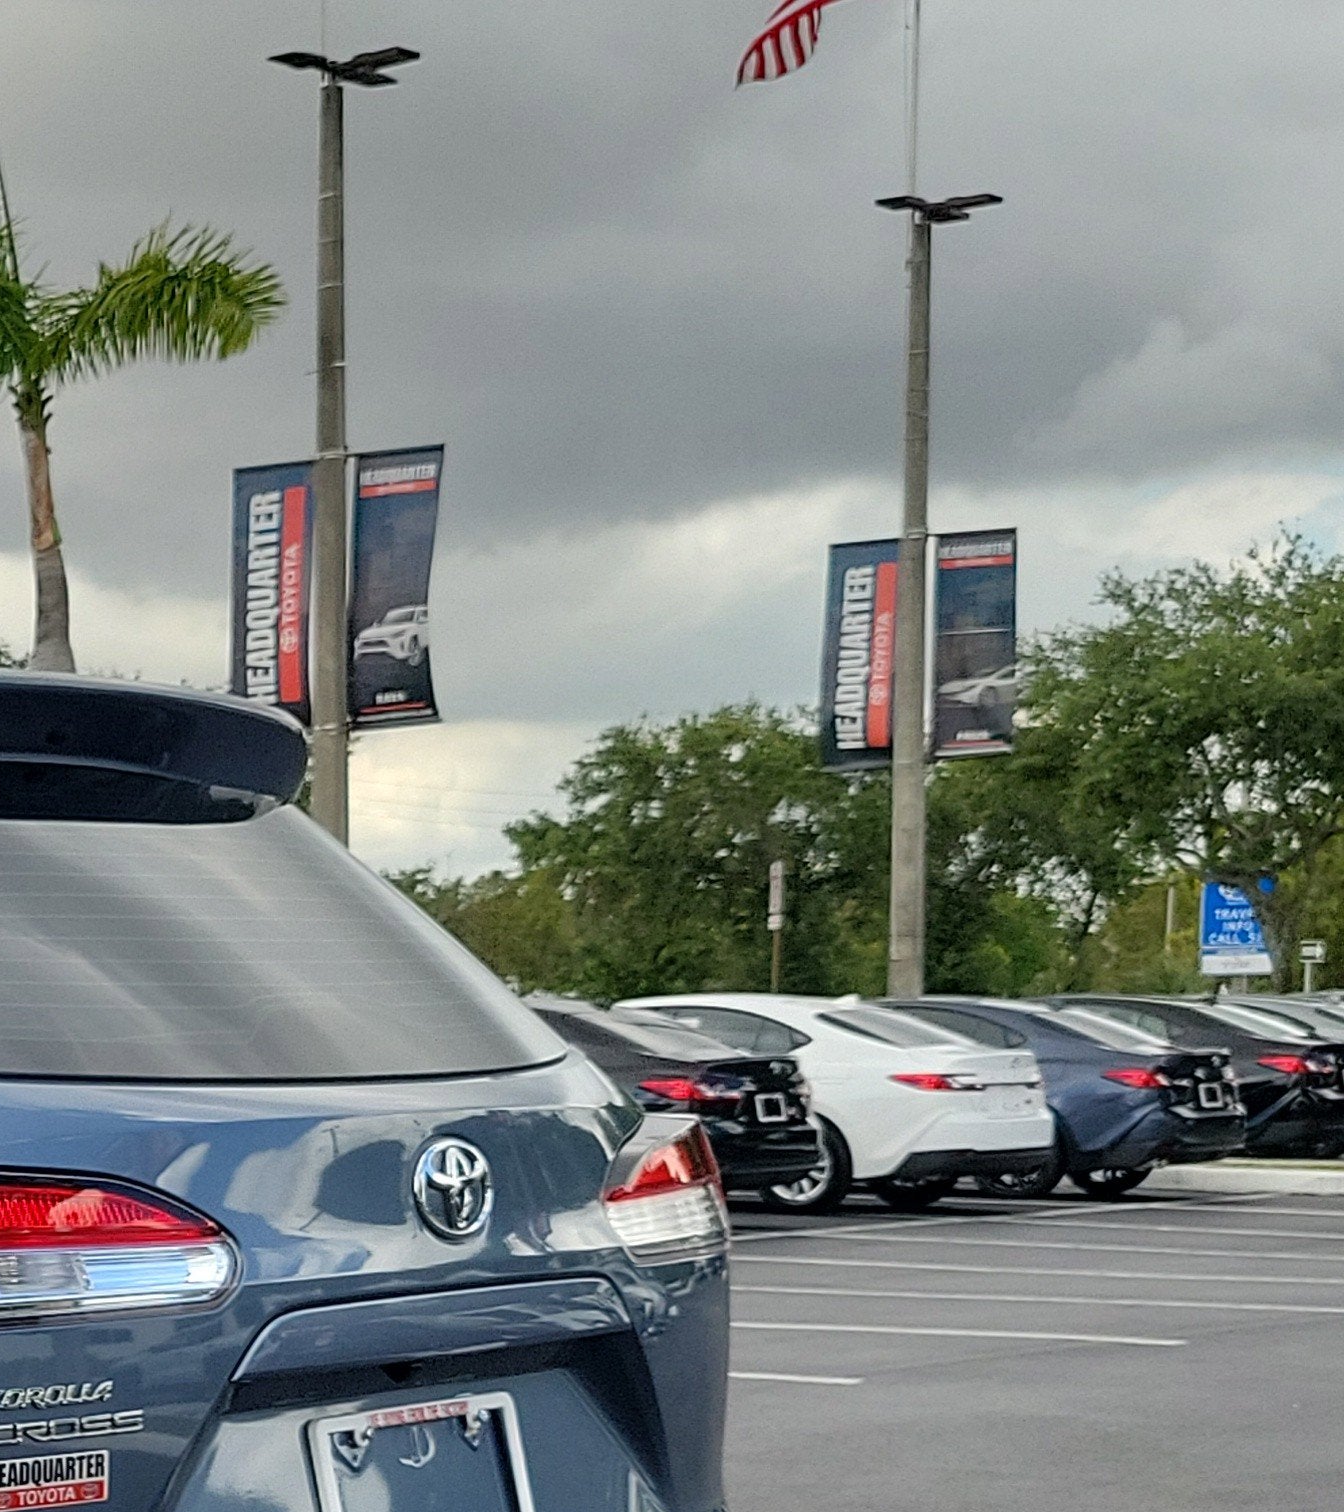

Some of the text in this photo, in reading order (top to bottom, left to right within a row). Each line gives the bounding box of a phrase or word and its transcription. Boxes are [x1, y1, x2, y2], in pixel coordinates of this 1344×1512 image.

[245, 490, 282, 704] HEADQUARTER
[281, 542, 300, 627] TOYOTA
[835, 564, 875, 750] HEADQUARTER
[870, 611, 893, 681] TOYOTA
[16, 1487, 77, 1506] TOYOTA
